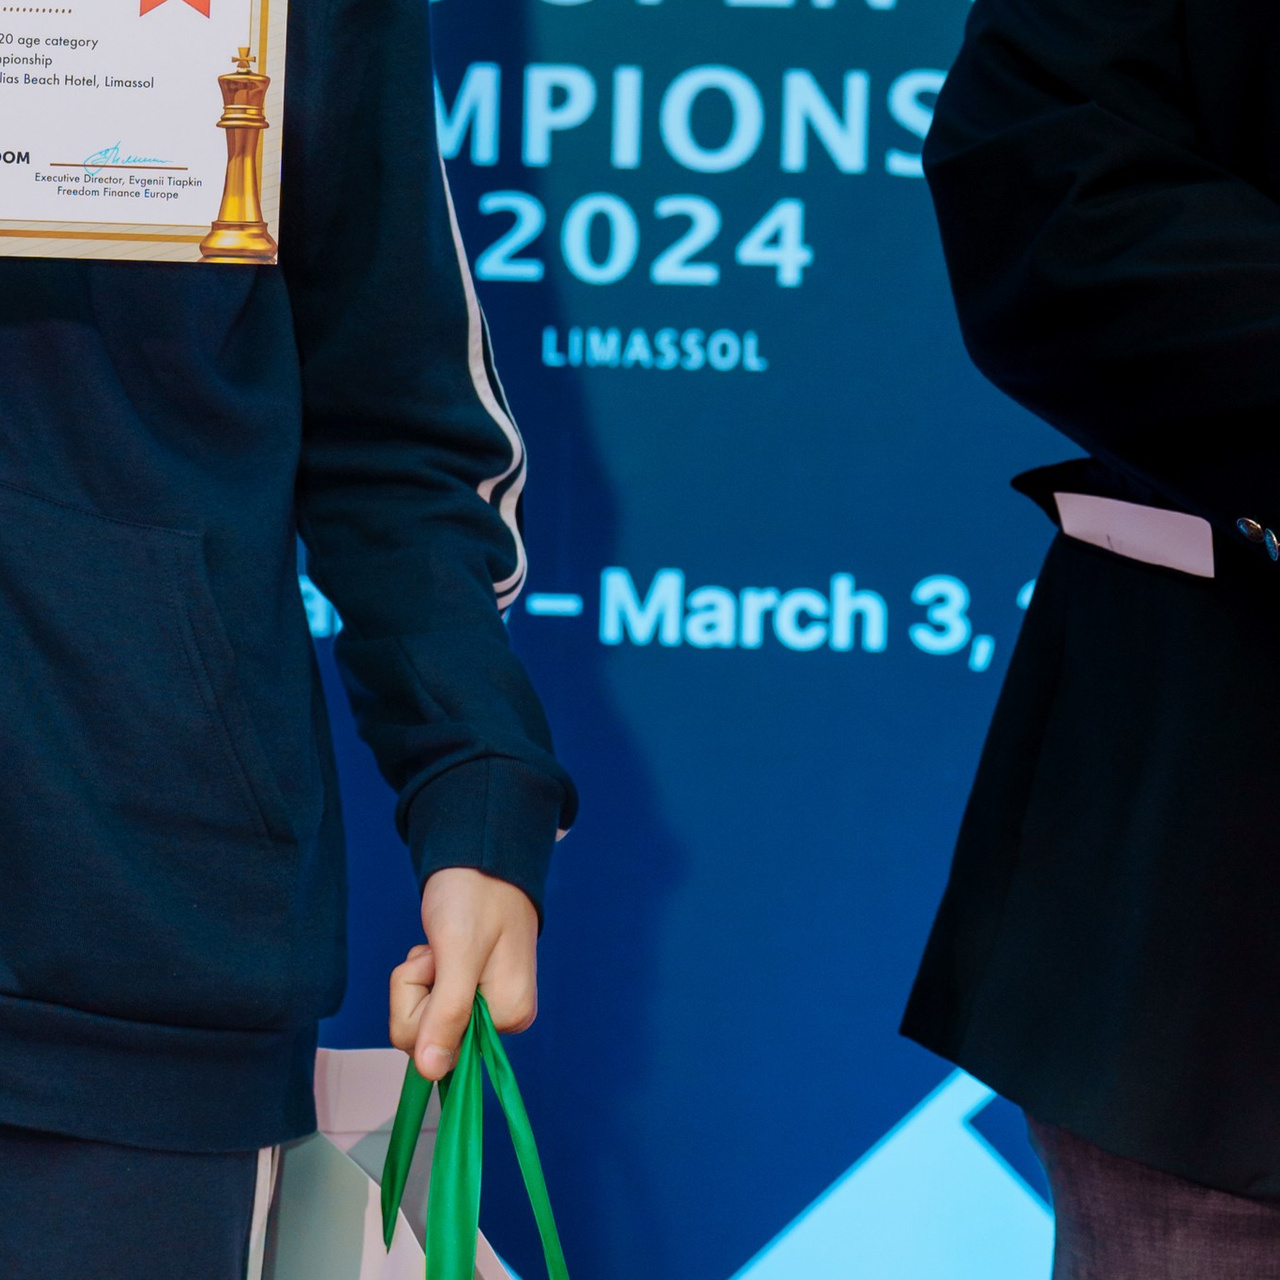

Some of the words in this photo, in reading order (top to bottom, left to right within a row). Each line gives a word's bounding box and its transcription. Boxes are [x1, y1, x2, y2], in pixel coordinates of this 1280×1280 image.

[18, 36, 41, 48] age
[45, 36, 99, 50] category
[24, 73, 60, 86] Beach
[64, 74, 100, 88] Hotel,
[105, 75, 154, 88] Limassol
[435, 61, 950, 178] MPIONS
[35, 172, 80, 184] Executive
[84, 174, 125, 186] Director,
[129, 175, 164, 187] Evgenii
[168, 176, 203, 189] Tiapkin
[57, 186, 100, 197] Freedom
[103, 187, 141, 198] Finance
[144, 189, 179, 200] Europe
[474, 190, 815, 288] 2024
[542, 325, 768, 372] LIMASSOL
[599, 566, 888, 653] March
[908, 574, 995, 672] 3,
